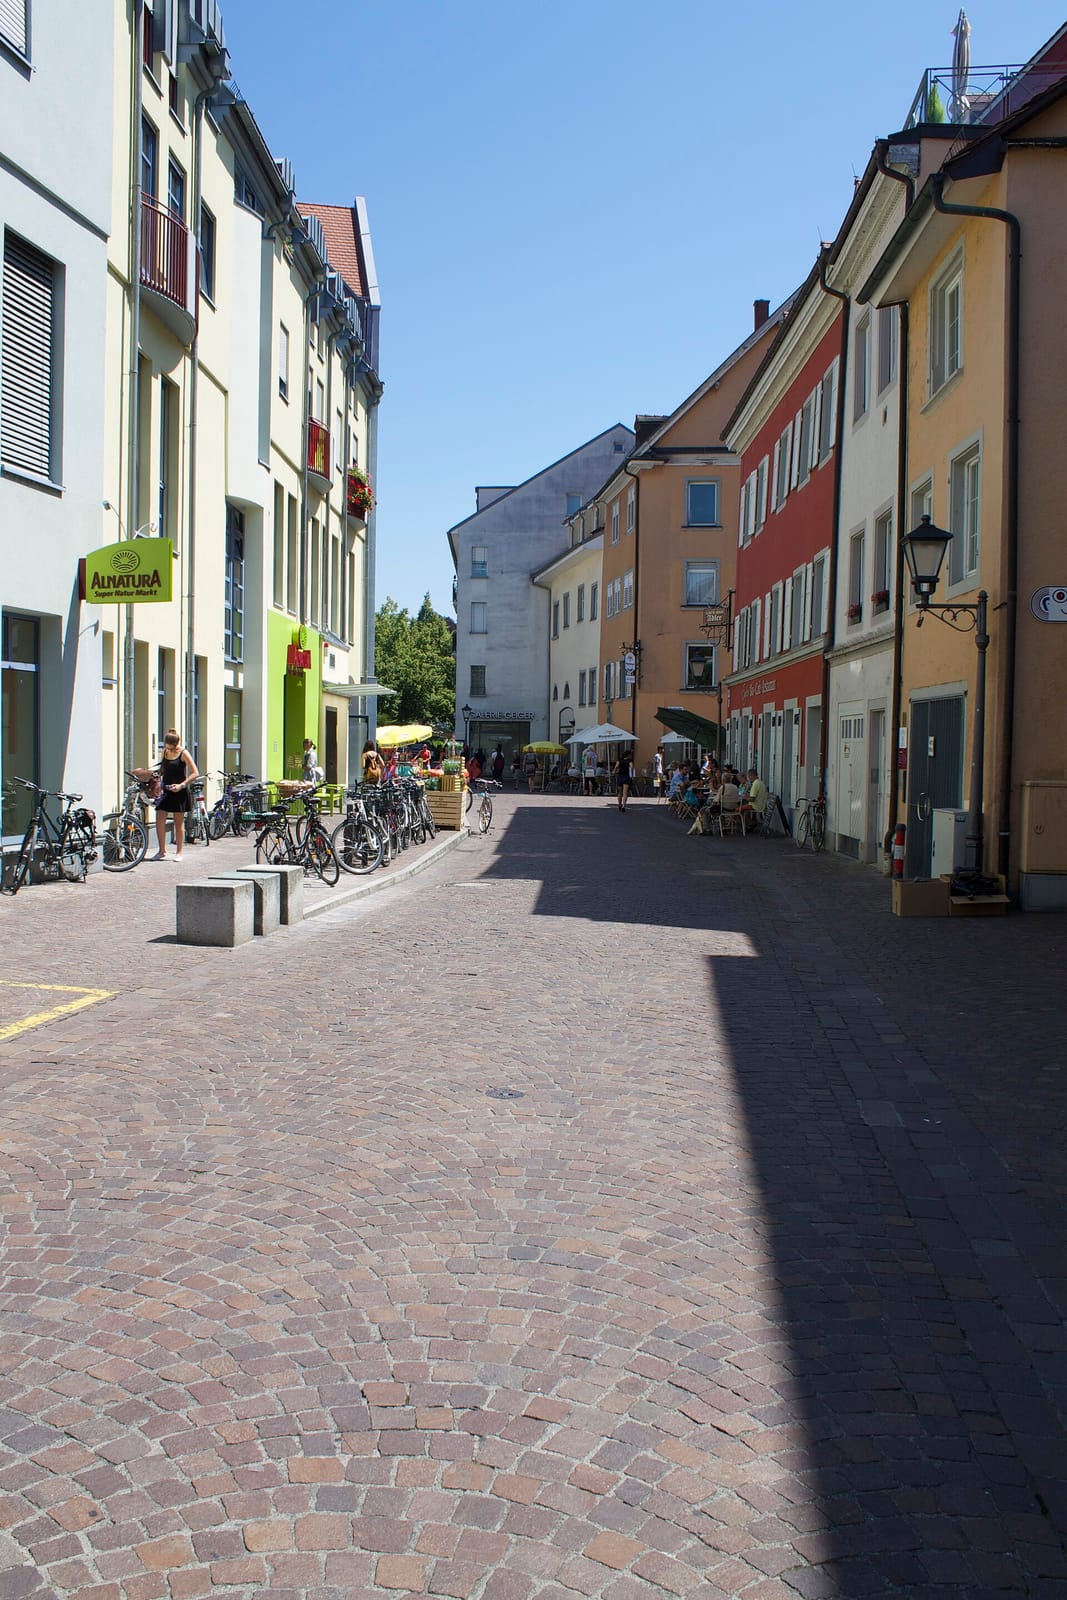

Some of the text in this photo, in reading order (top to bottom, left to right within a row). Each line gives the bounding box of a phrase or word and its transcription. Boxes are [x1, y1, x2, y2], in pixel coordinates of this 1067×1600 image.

[91, 569, 162, 589] ALNATURA
[94, 590, 114, 598] Super
[135, 588, 157, 596] Markt
